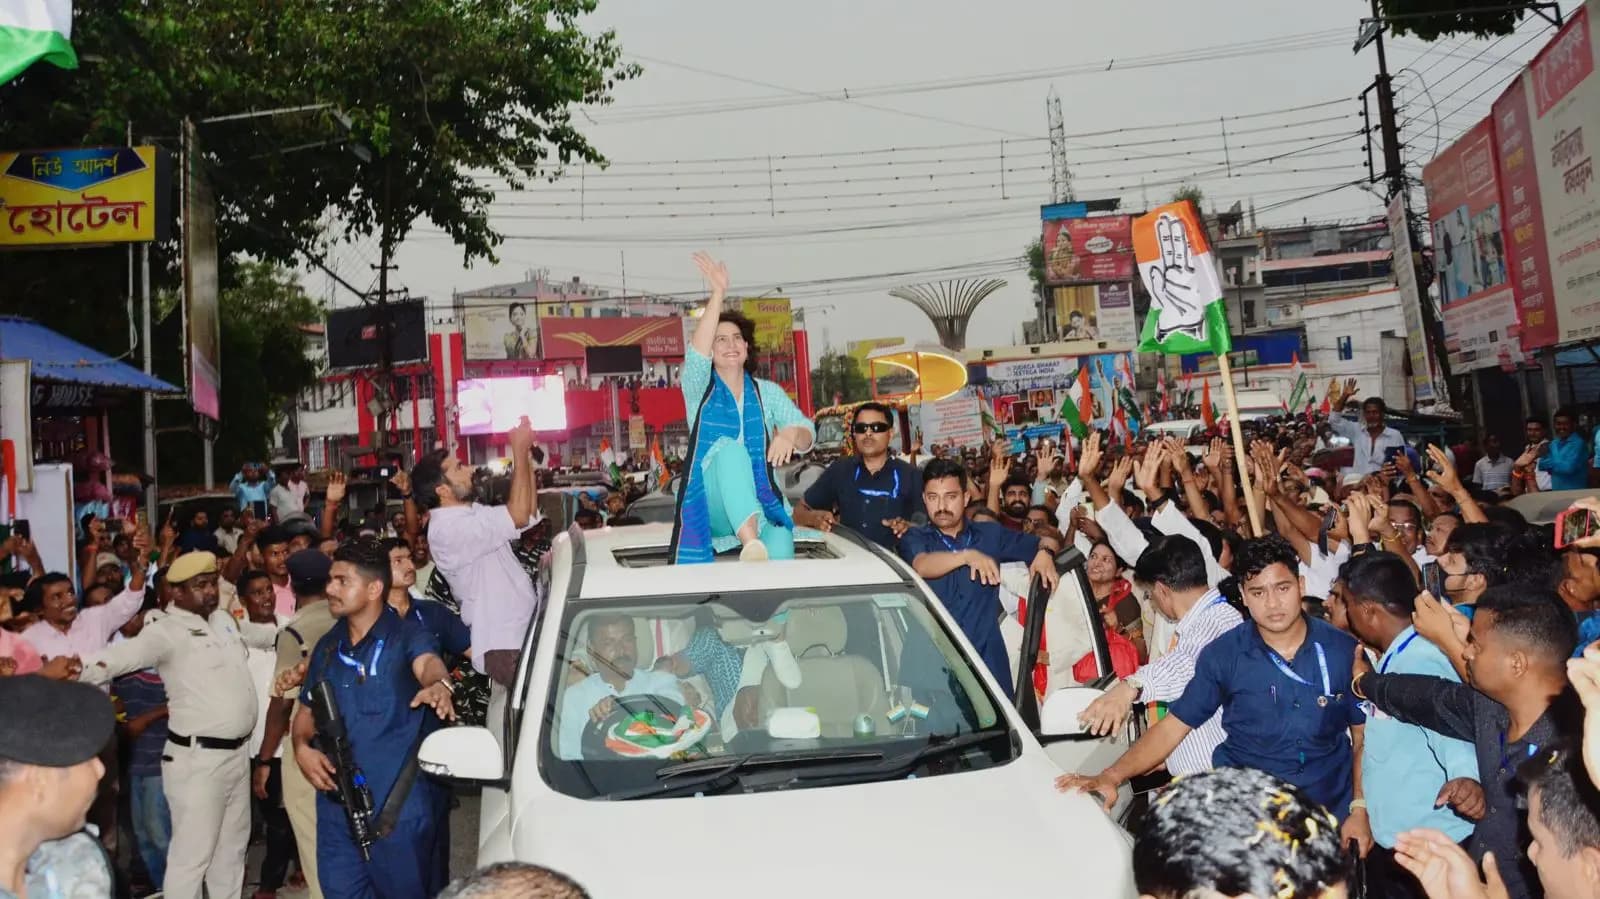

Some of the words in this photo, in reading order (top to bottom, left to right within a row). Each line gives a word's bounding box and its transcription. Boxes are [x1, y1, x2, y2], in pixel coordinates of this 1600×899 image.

[32, 157, 62, 179] নিউ
[72, 153, 119, 176] আদর্শ
[7, 192, 147, 237] হোটেল
[47, 384, 94, 407] HOUSE
